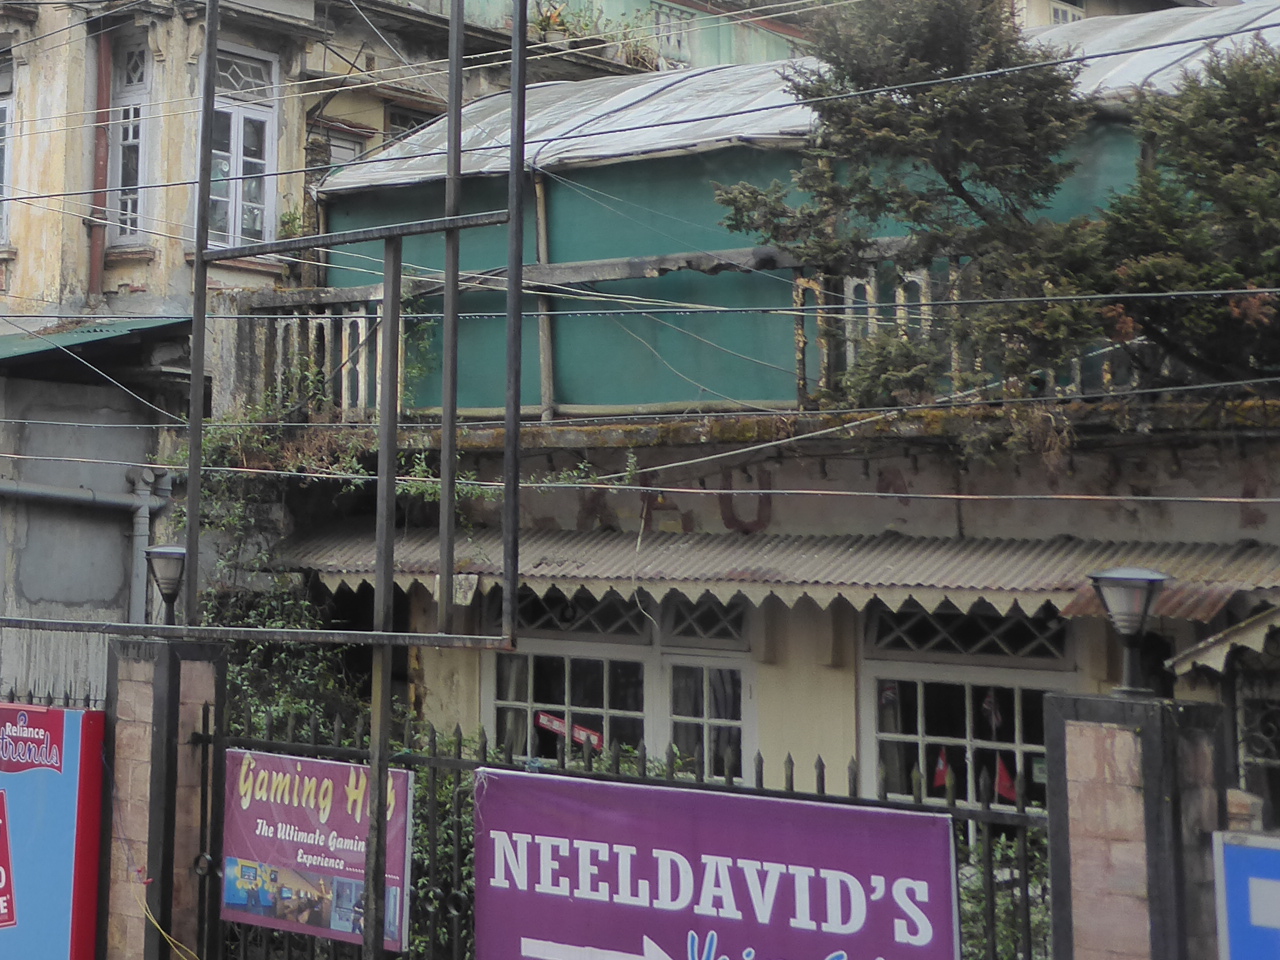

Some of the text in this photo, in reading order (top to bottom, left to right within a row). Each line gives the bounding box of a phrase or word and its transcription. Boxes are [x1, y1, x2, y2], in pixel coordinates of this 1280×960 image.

[5, 722, 45, 739] Reliance
[238, 752, 333, 823] Gaming
[255, 818, 366, 852] The Ultimate Gamin
[296, 848, 345, 871] Experience
[489, 829, 935, 947] NEELDAVID'S
